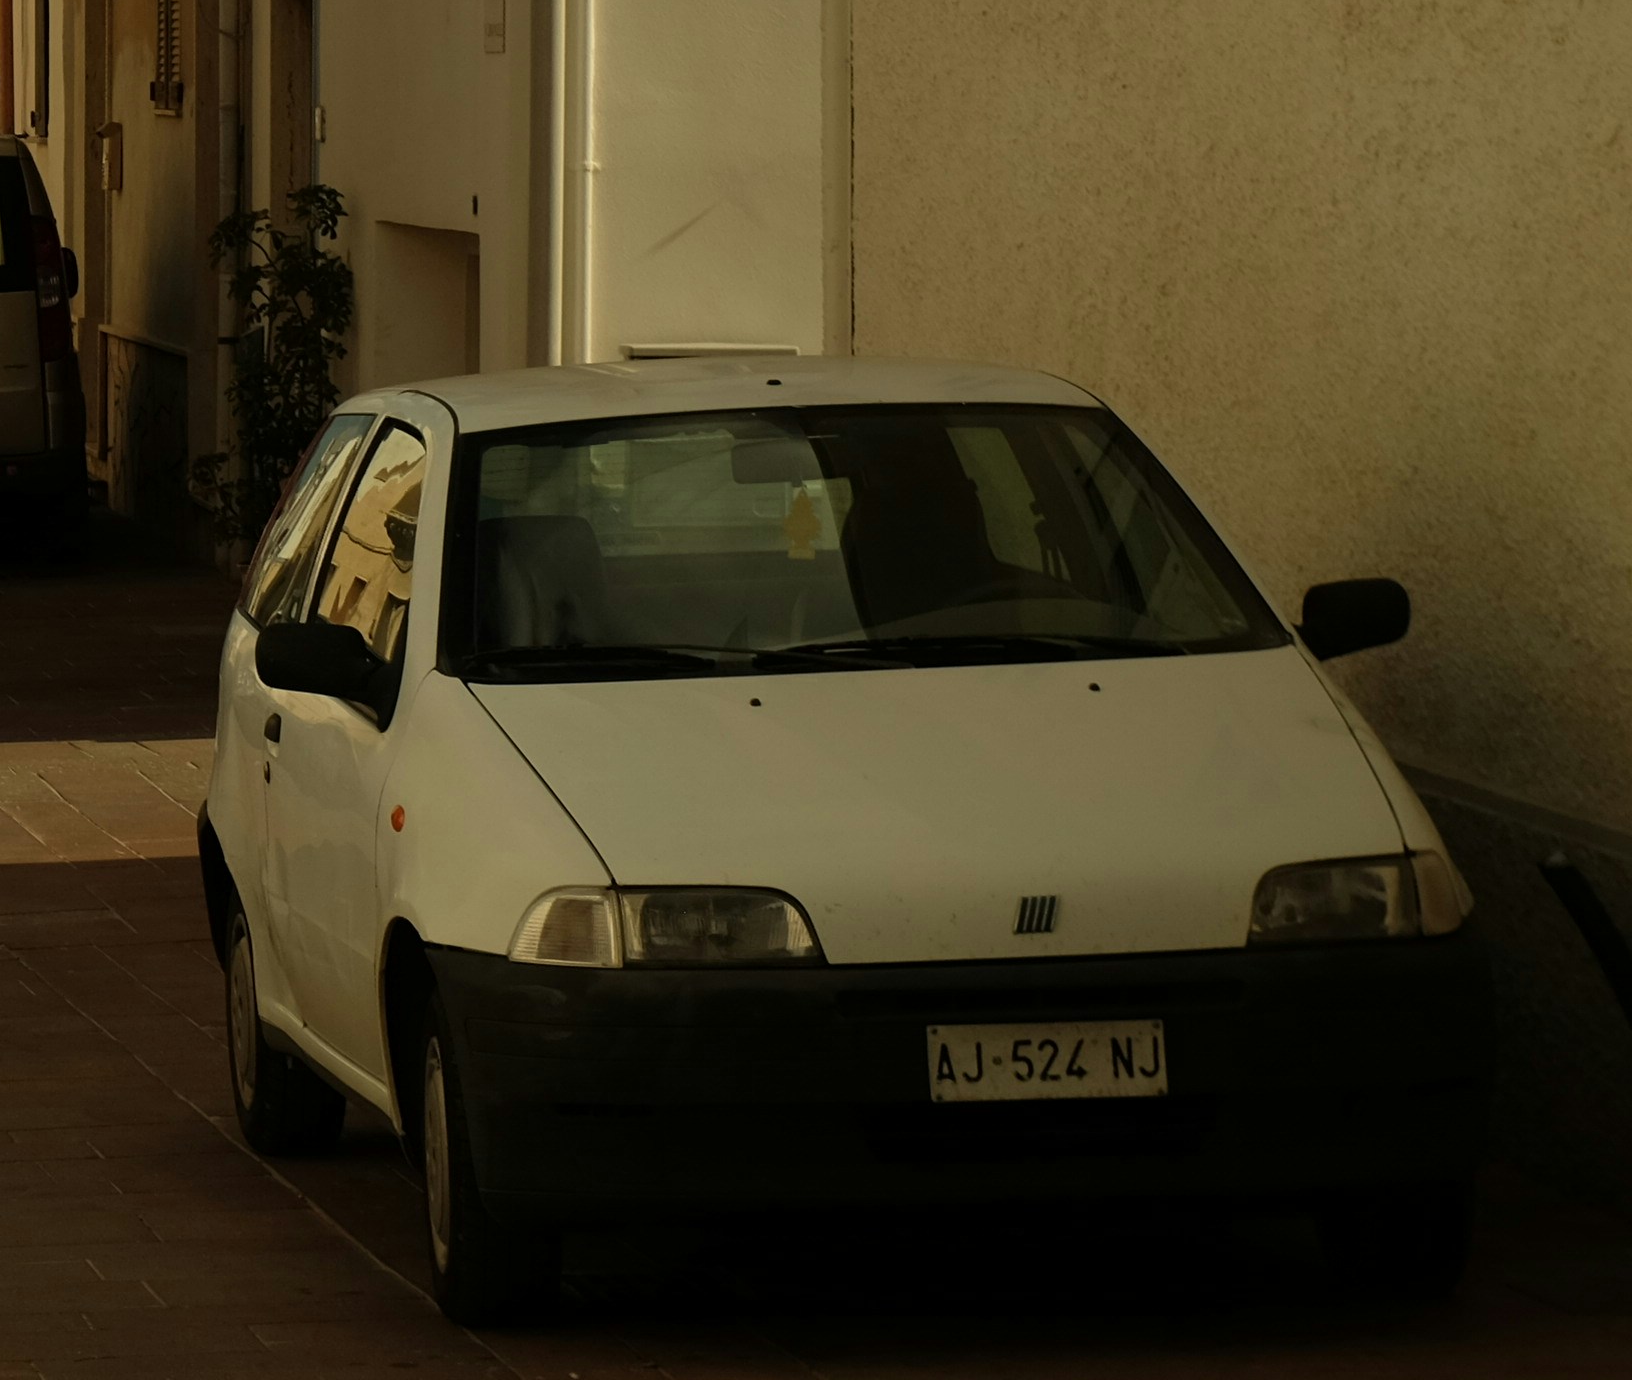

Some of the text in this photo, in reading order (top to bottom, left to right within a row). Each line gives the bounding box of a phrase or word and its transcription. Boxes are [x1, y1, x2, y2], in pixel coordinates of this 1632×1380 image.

[936, 1036, 1159, 1083] AJ 524 NJ
